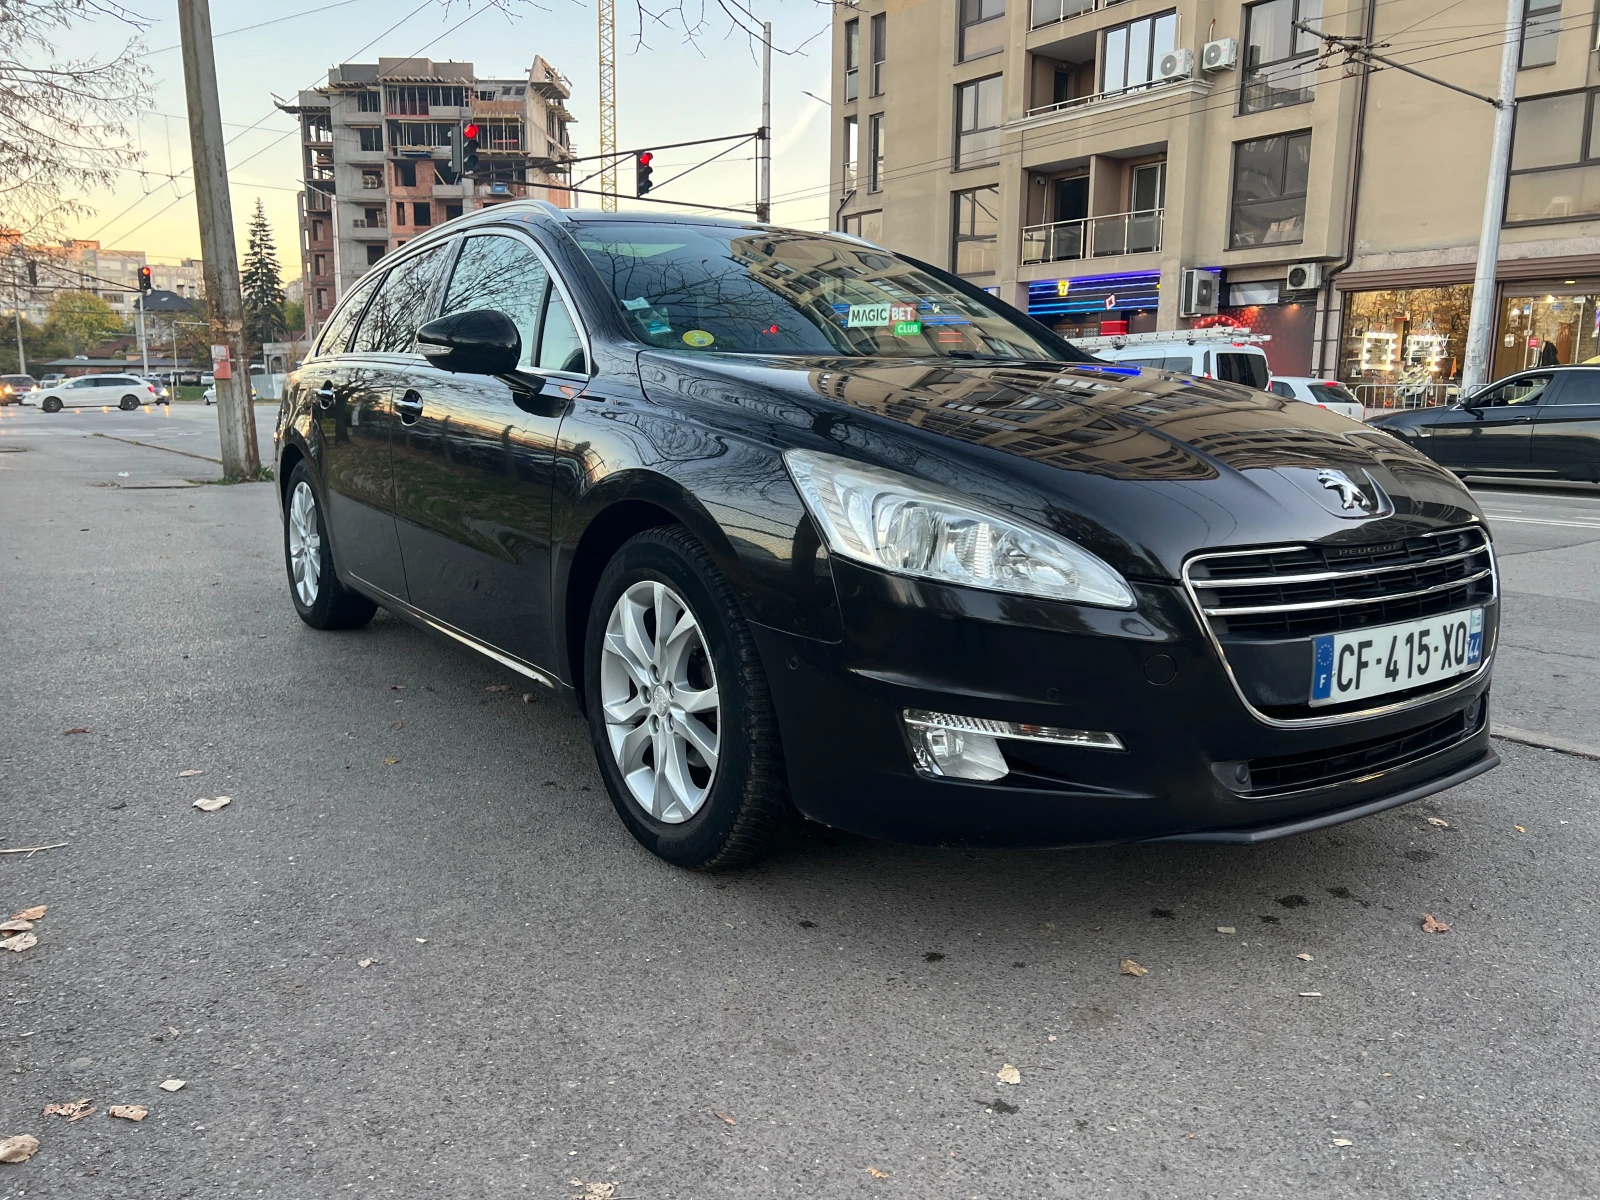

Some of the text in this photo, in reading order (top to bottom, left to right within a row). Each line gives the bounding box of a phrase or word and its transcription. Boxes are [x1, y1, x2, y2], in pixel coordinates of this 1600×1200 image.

[852, 307, 914, 322] MAGIC BET
[897, 324, 919, 333] CLUB
[1339, 545, 1397, 556] PEUGEOT
[1319, 674, 1327, 689] F
[1468, 638, 1480, 659] 44
